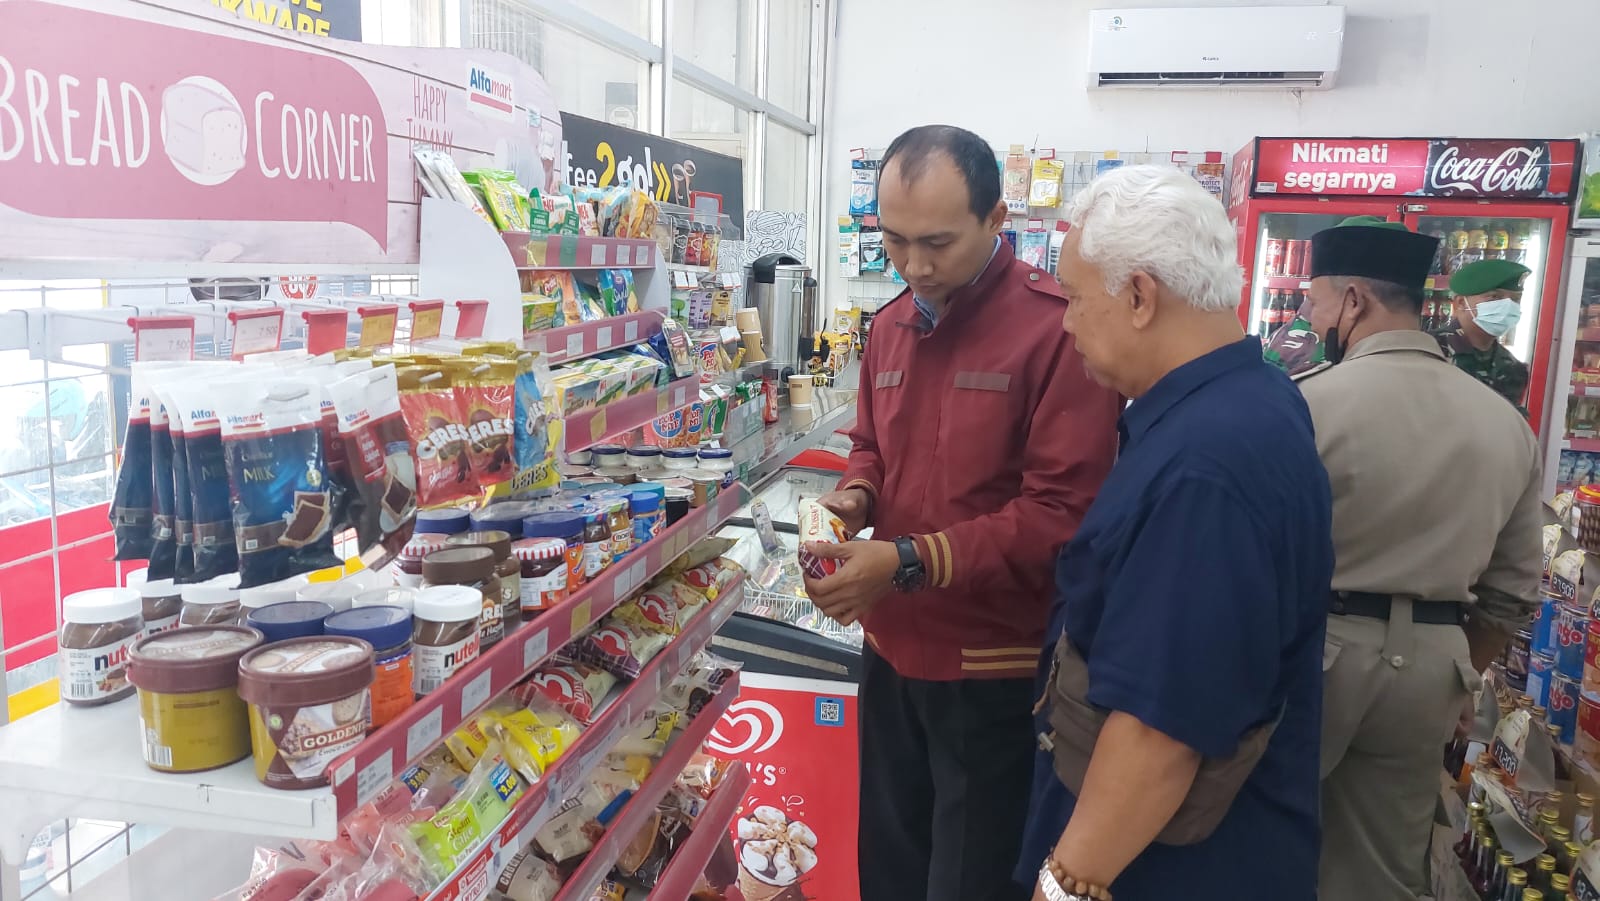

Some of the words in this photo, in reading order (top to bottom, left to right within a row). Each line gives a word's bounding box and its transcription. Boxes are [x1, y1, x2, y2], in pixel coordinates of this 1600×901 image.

[413, 75, 447, 124] HAPPY
[470, 67, 513, 102] Alfamart
[0, 56, 150, 168] BREAD
[255, 91, 375, 183] CORNER
[1292, 143, 1389, 164] Nikmati
[1431, 146, 1545, 193] Coca-Cola
[617, 147, 655, 202] go!
[1283, 171, 1397, 193] segarnya
[467, 418, 514, 444] ERES
[243, 466, 276, 483] MILK
